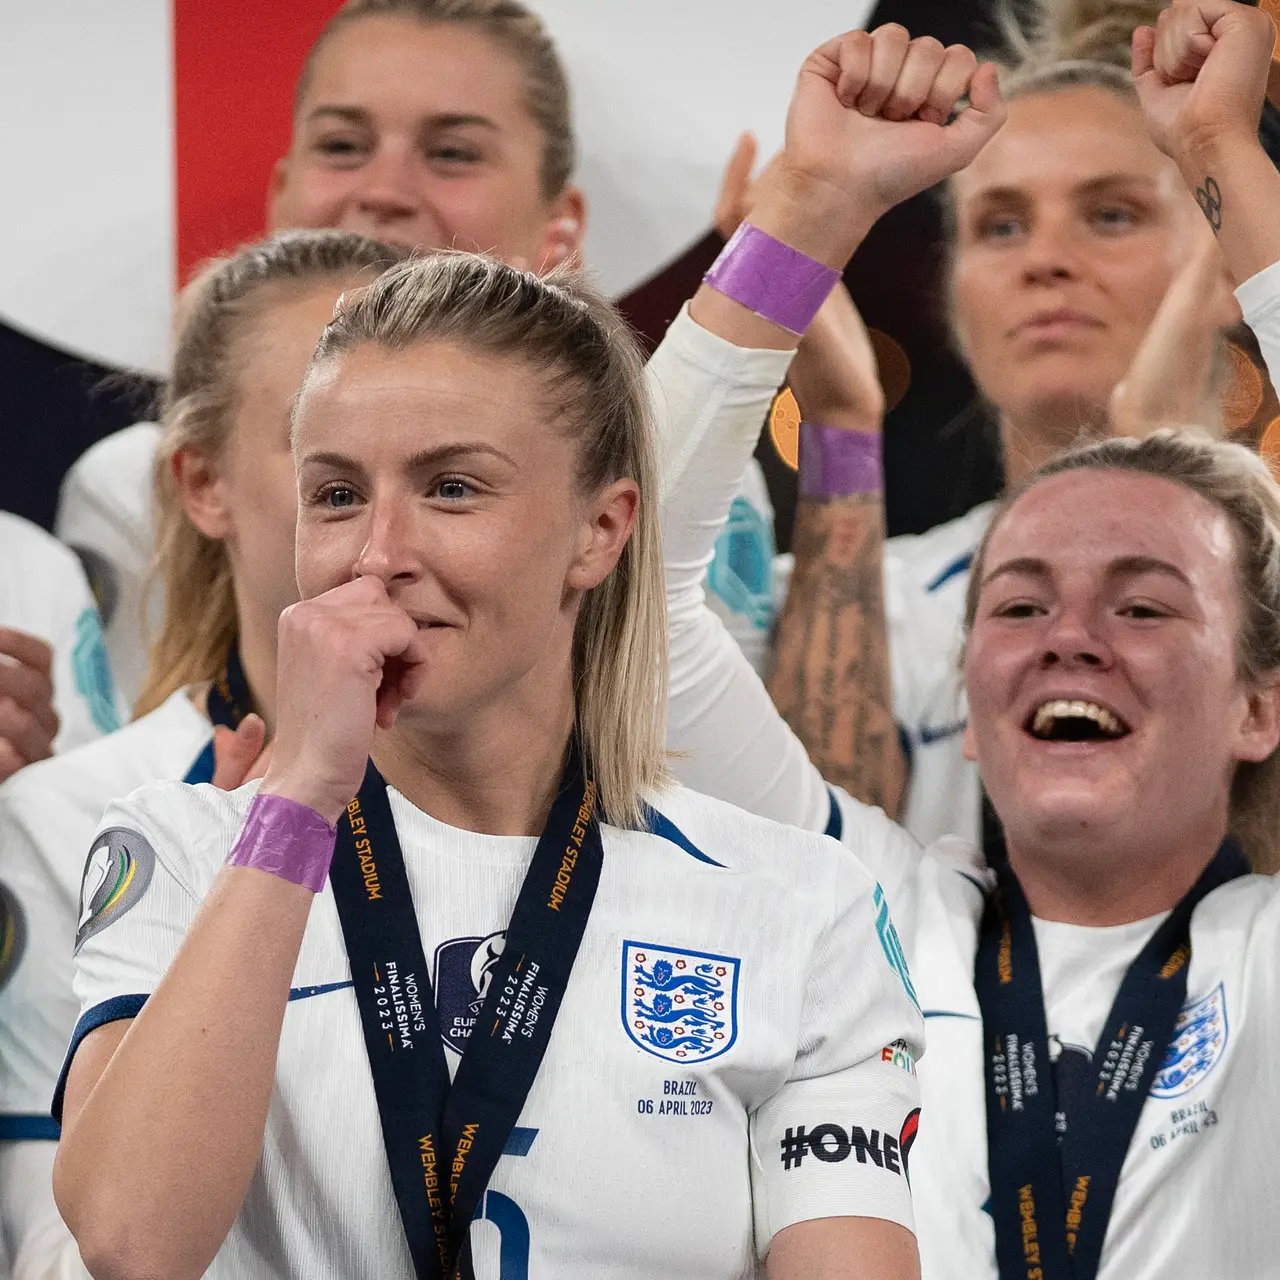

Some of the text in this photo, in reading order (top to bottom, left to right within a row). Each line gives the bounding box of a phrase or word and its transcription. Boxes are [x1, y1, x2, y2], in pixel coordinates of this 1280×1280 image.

[346, 797, 383, 900] BLEY STADIUM
[547, 845, 578, 911] STADIUM
[373, 985, 394, 1030] 2023
[404, 973, 426, 1032] WOMEN'S
[496, 974, 518, 1017] 2023
[520, 985, 549, 1039] WOMEN'S
[637, 1099, 714, 1116] 06 APRIL 2023
[663, 1080, 697, 1096] BRAZIL
[418, 1133, 445, 1218] WEMBLEY
[1019, 1184, 1041, 1265] WEMBLEY
